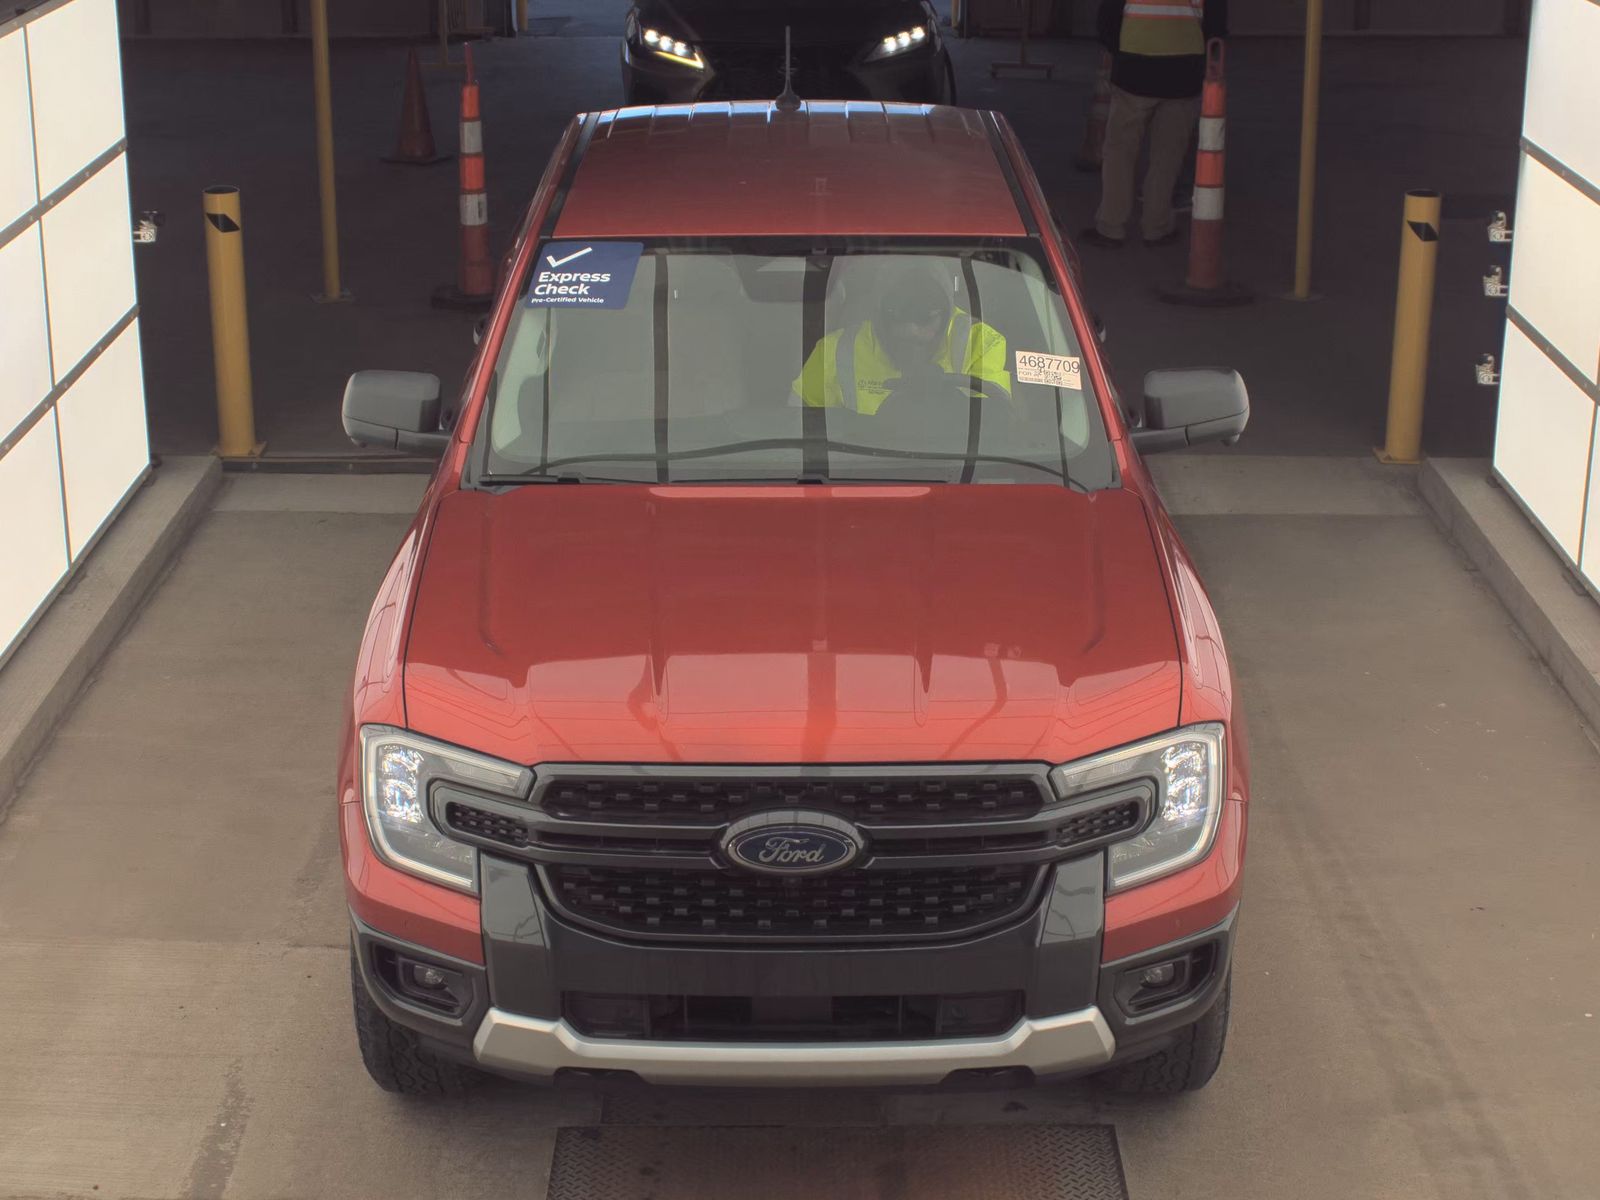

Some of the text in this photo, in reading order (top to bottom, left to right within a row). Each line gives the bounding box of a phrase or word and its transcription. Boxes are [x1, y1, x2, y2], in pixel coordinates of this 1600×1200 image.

[538, 271, 611, 284] Express
[534, 283, 590, 295] Check
[1019, 355, 1080, 374] 4687709
[758, 836, 826, 863] Ford
